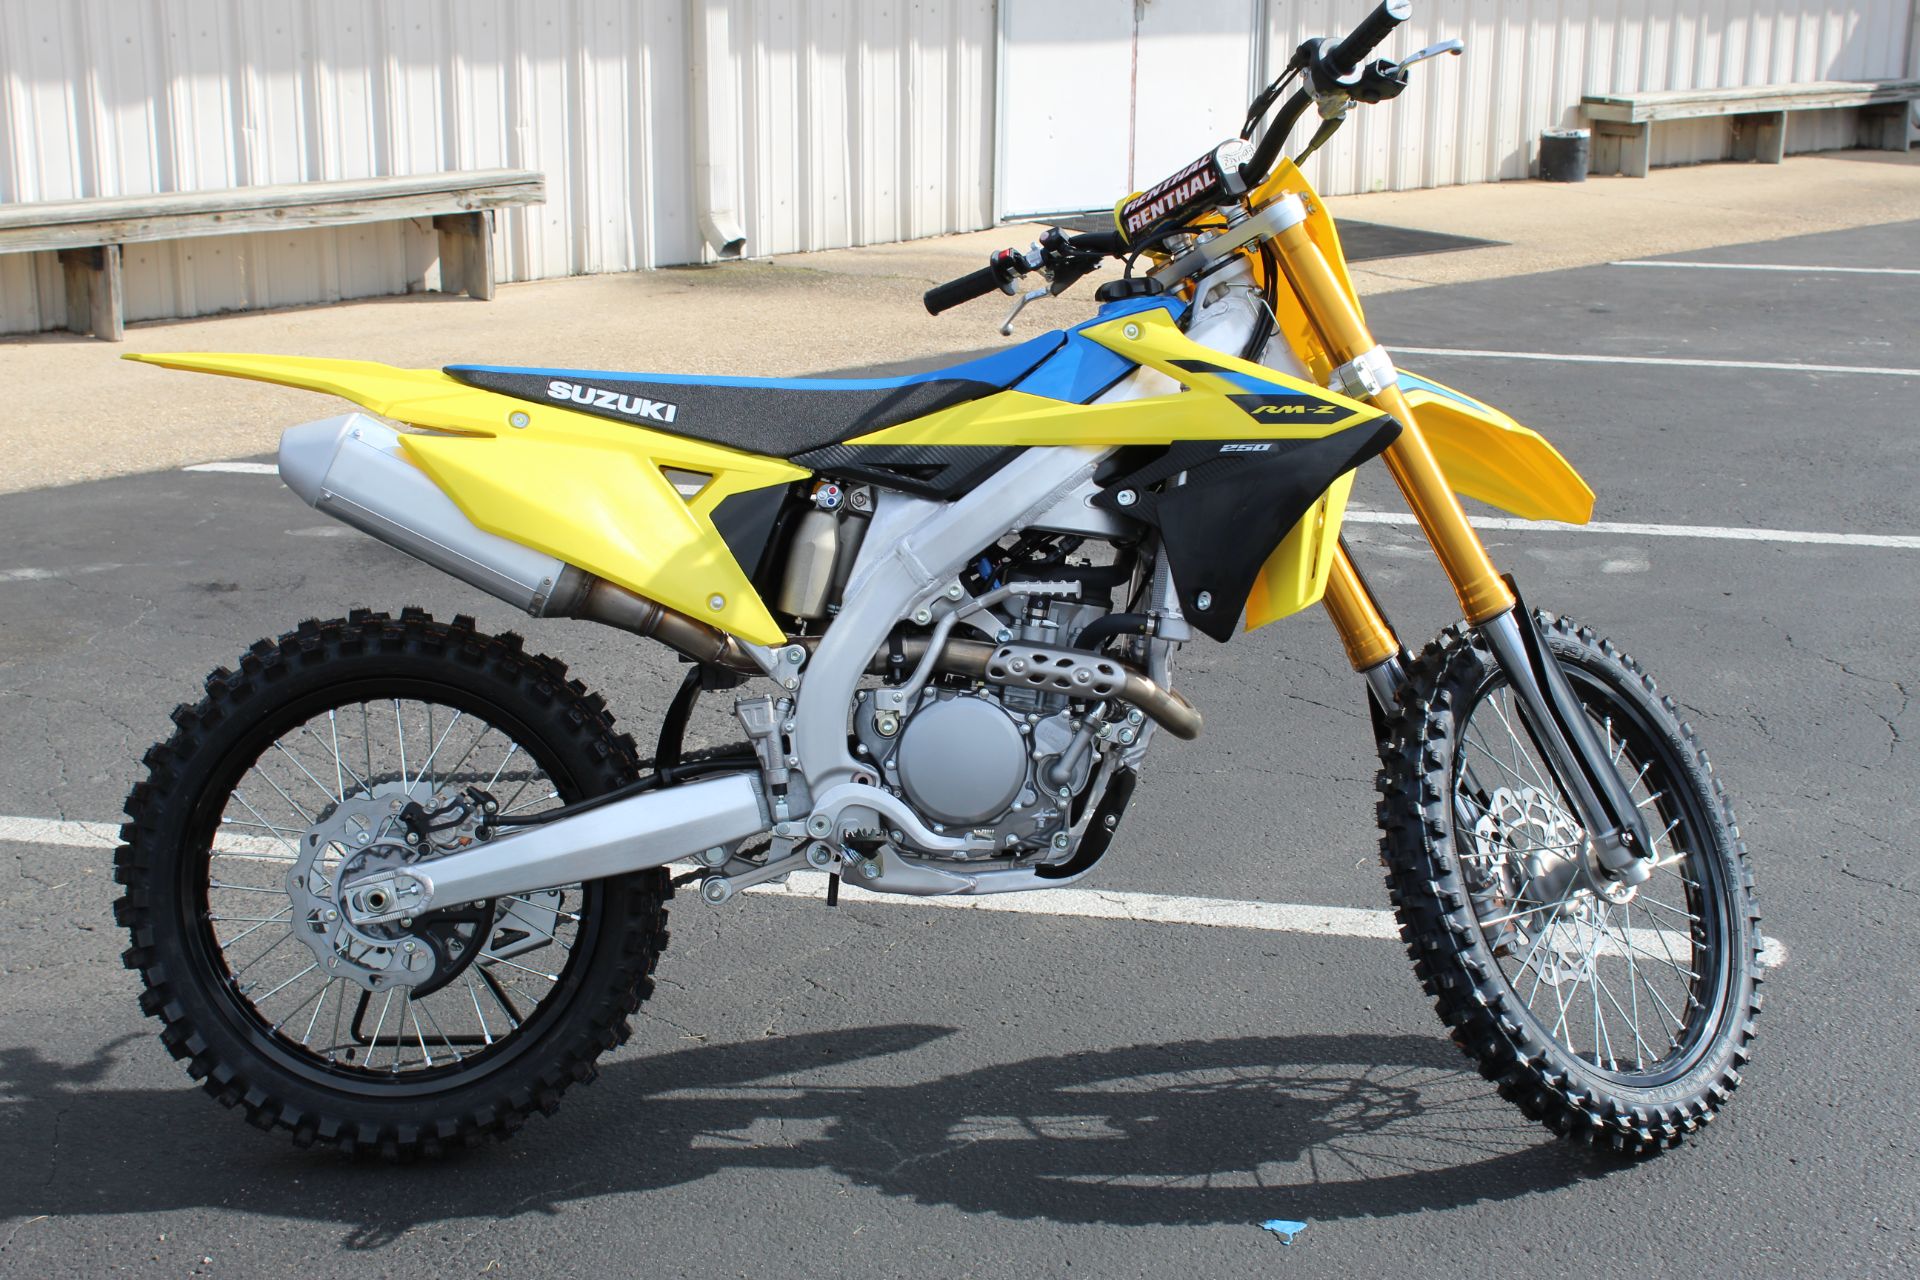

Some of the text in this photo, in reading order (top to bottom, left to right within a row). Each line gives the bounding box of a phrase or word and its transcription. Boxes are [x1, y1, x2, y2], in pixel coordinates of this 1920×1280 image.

[1123, 153, 1212, 215] RENTHAL
[1127, 169, 1217, 233] RENTHAL
[547, 381, 677, 423] SUZUKI
[1250, 405, 1337, 414] RM-Z
[1219, 443, 1272, 453] 250
